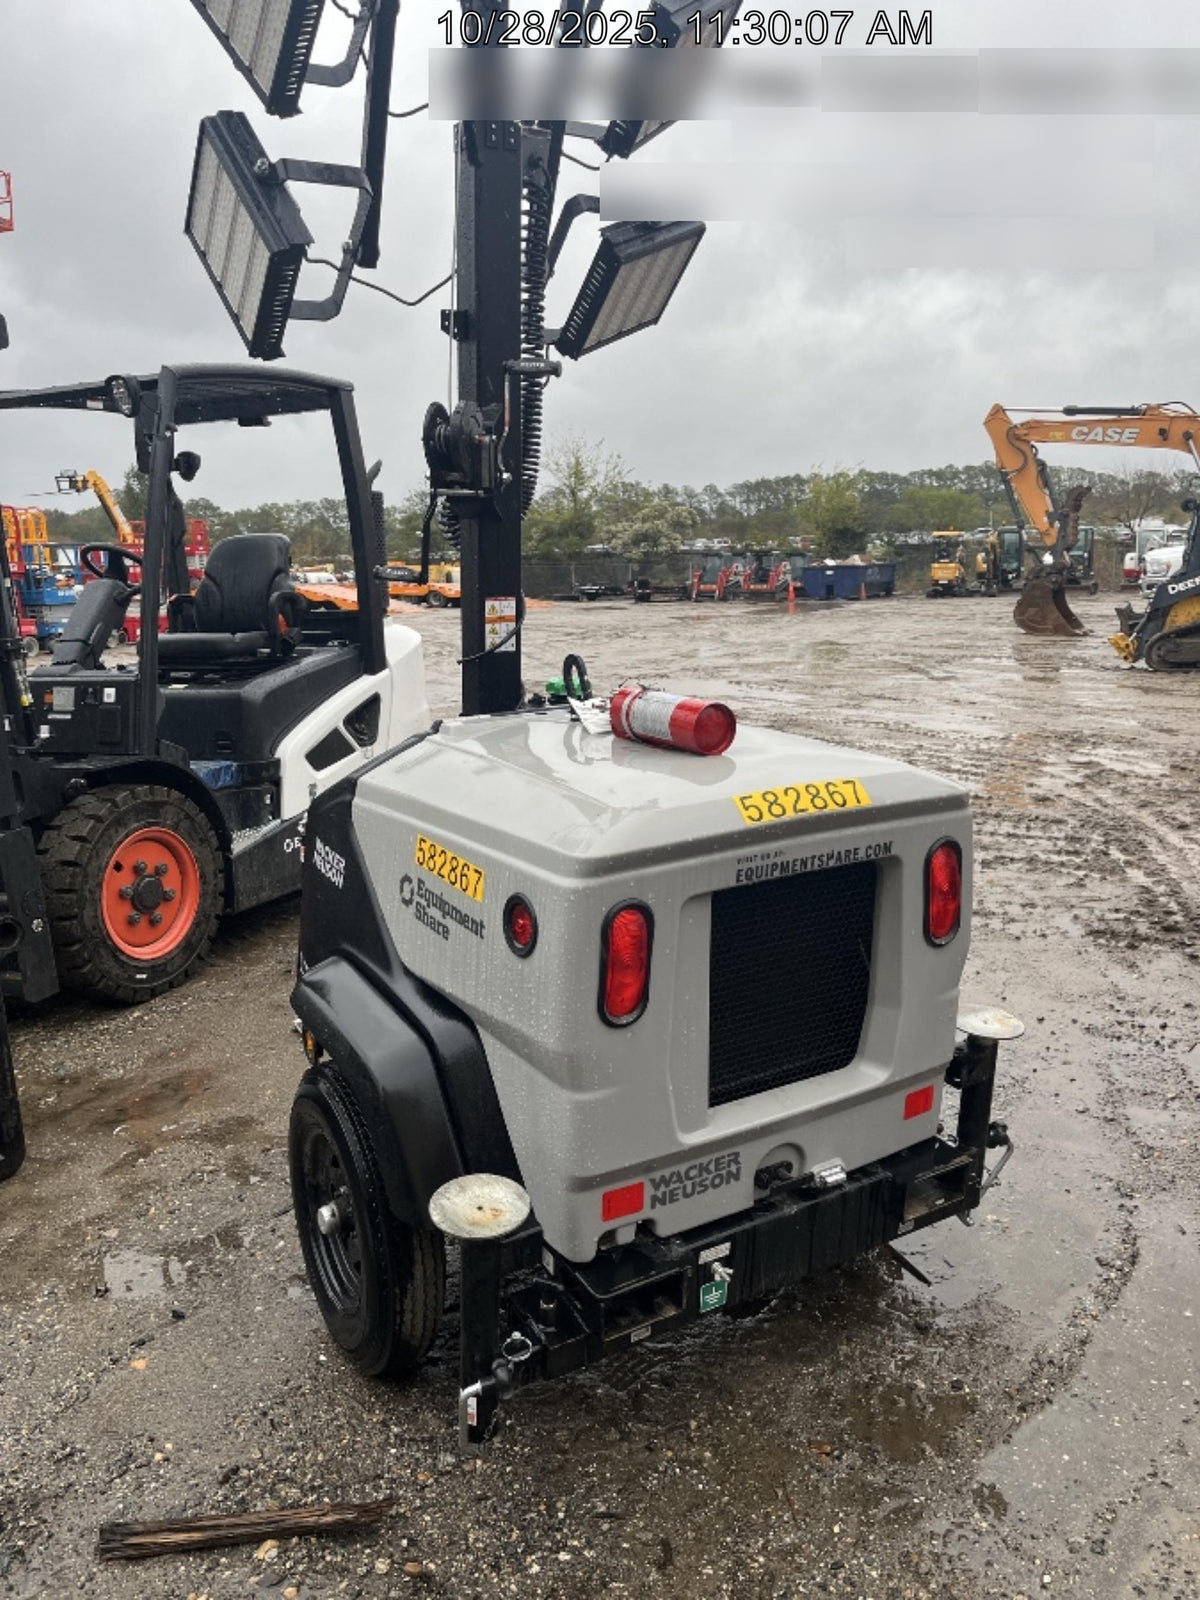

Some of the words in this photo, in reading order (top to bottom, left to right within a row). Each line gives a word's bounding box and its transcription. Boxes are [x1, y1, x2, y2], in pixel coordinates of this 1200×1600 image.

[1070, 425, 1140, 443] CASE
[738, 780, 862, 822] 582867
[416, 837, 483, 899] 582867
[735, 840, 894, 884] EQUIPMENTSHARE.COM
[414, 901, 450, 941] Share
[416, 876, 486, 940] Equipment
[648, 1151, 742, 1191] WACKER
[650, 1166, 742, 1210] NEUSON
